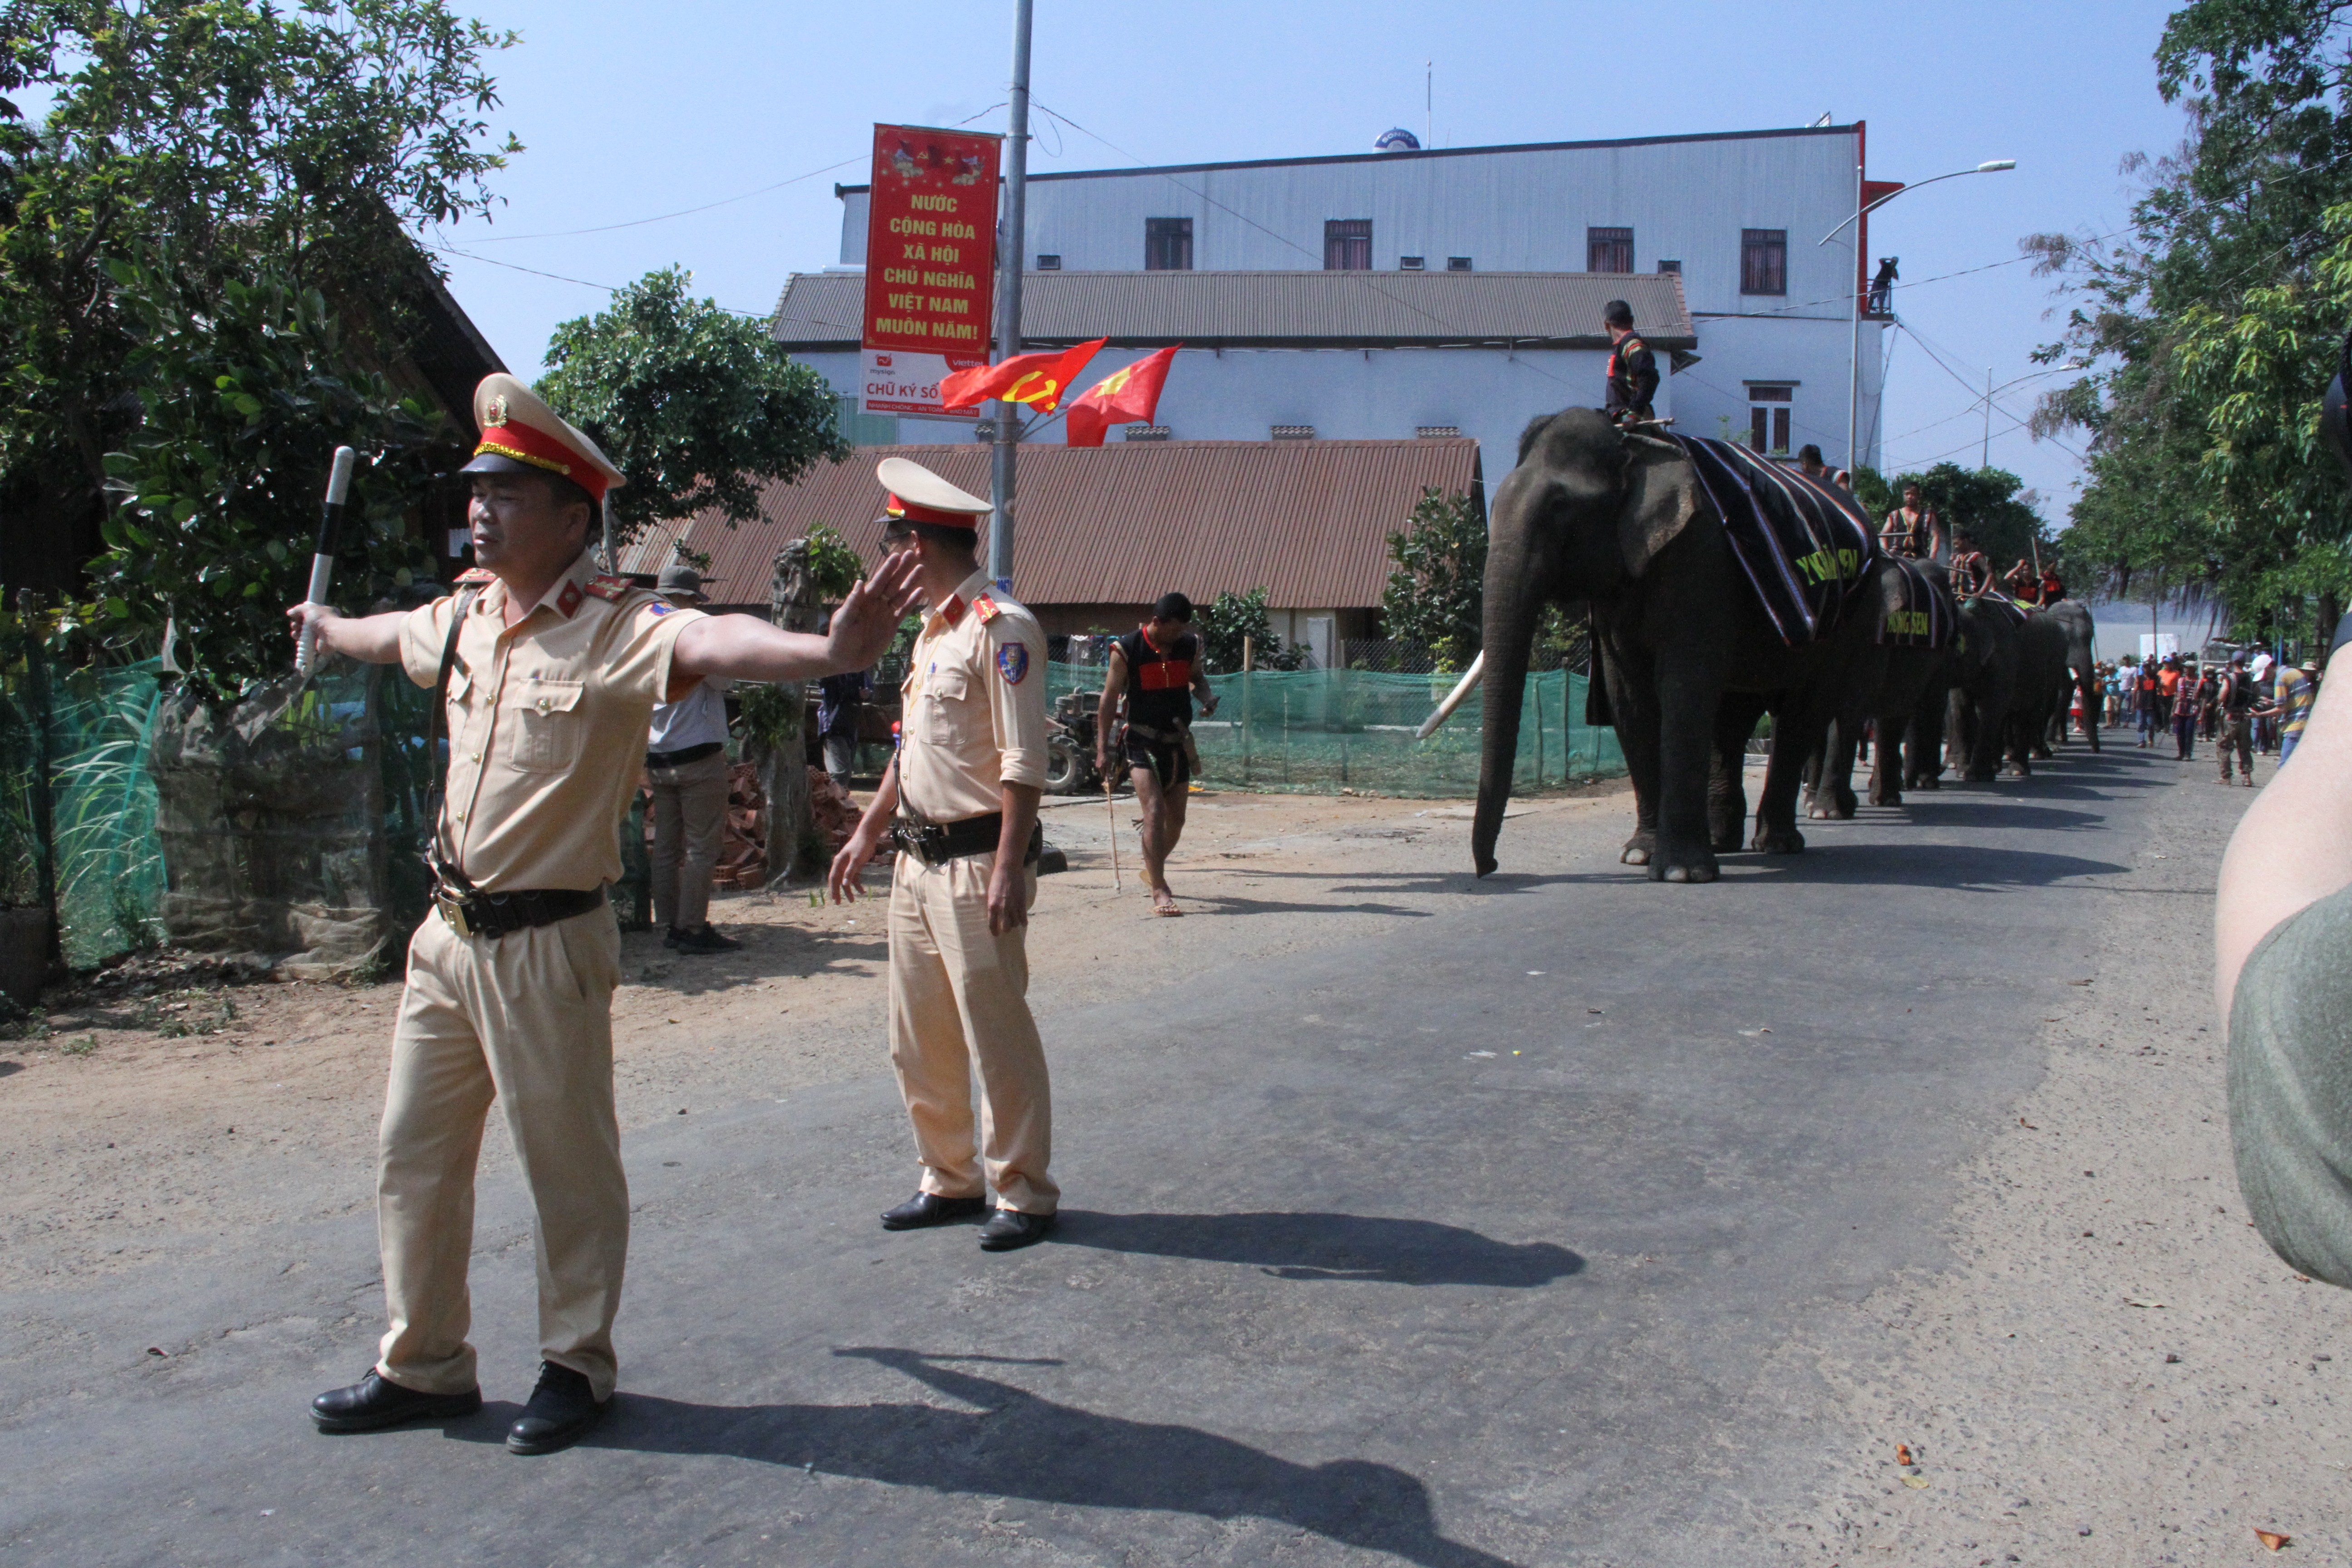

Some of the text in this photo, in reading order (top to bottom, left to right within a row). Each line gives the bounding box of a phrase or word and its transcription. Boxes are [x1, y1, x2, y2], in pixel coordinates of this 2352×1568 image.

[911, 194, 958, 212] NƯỚC
[890, 216, 975, 240] CỘNG HÒA
[903, 243, 960, 265] XÃ HỘI
[884, 265, 975, 289] CHỦ NGHĨA
[888, 292, 969, 314] VIỆT NAM
[876, 317, 978, 340] MUÔN NĂM!
[867, 381, 940, 399] CHỮ KÝ SỐ
